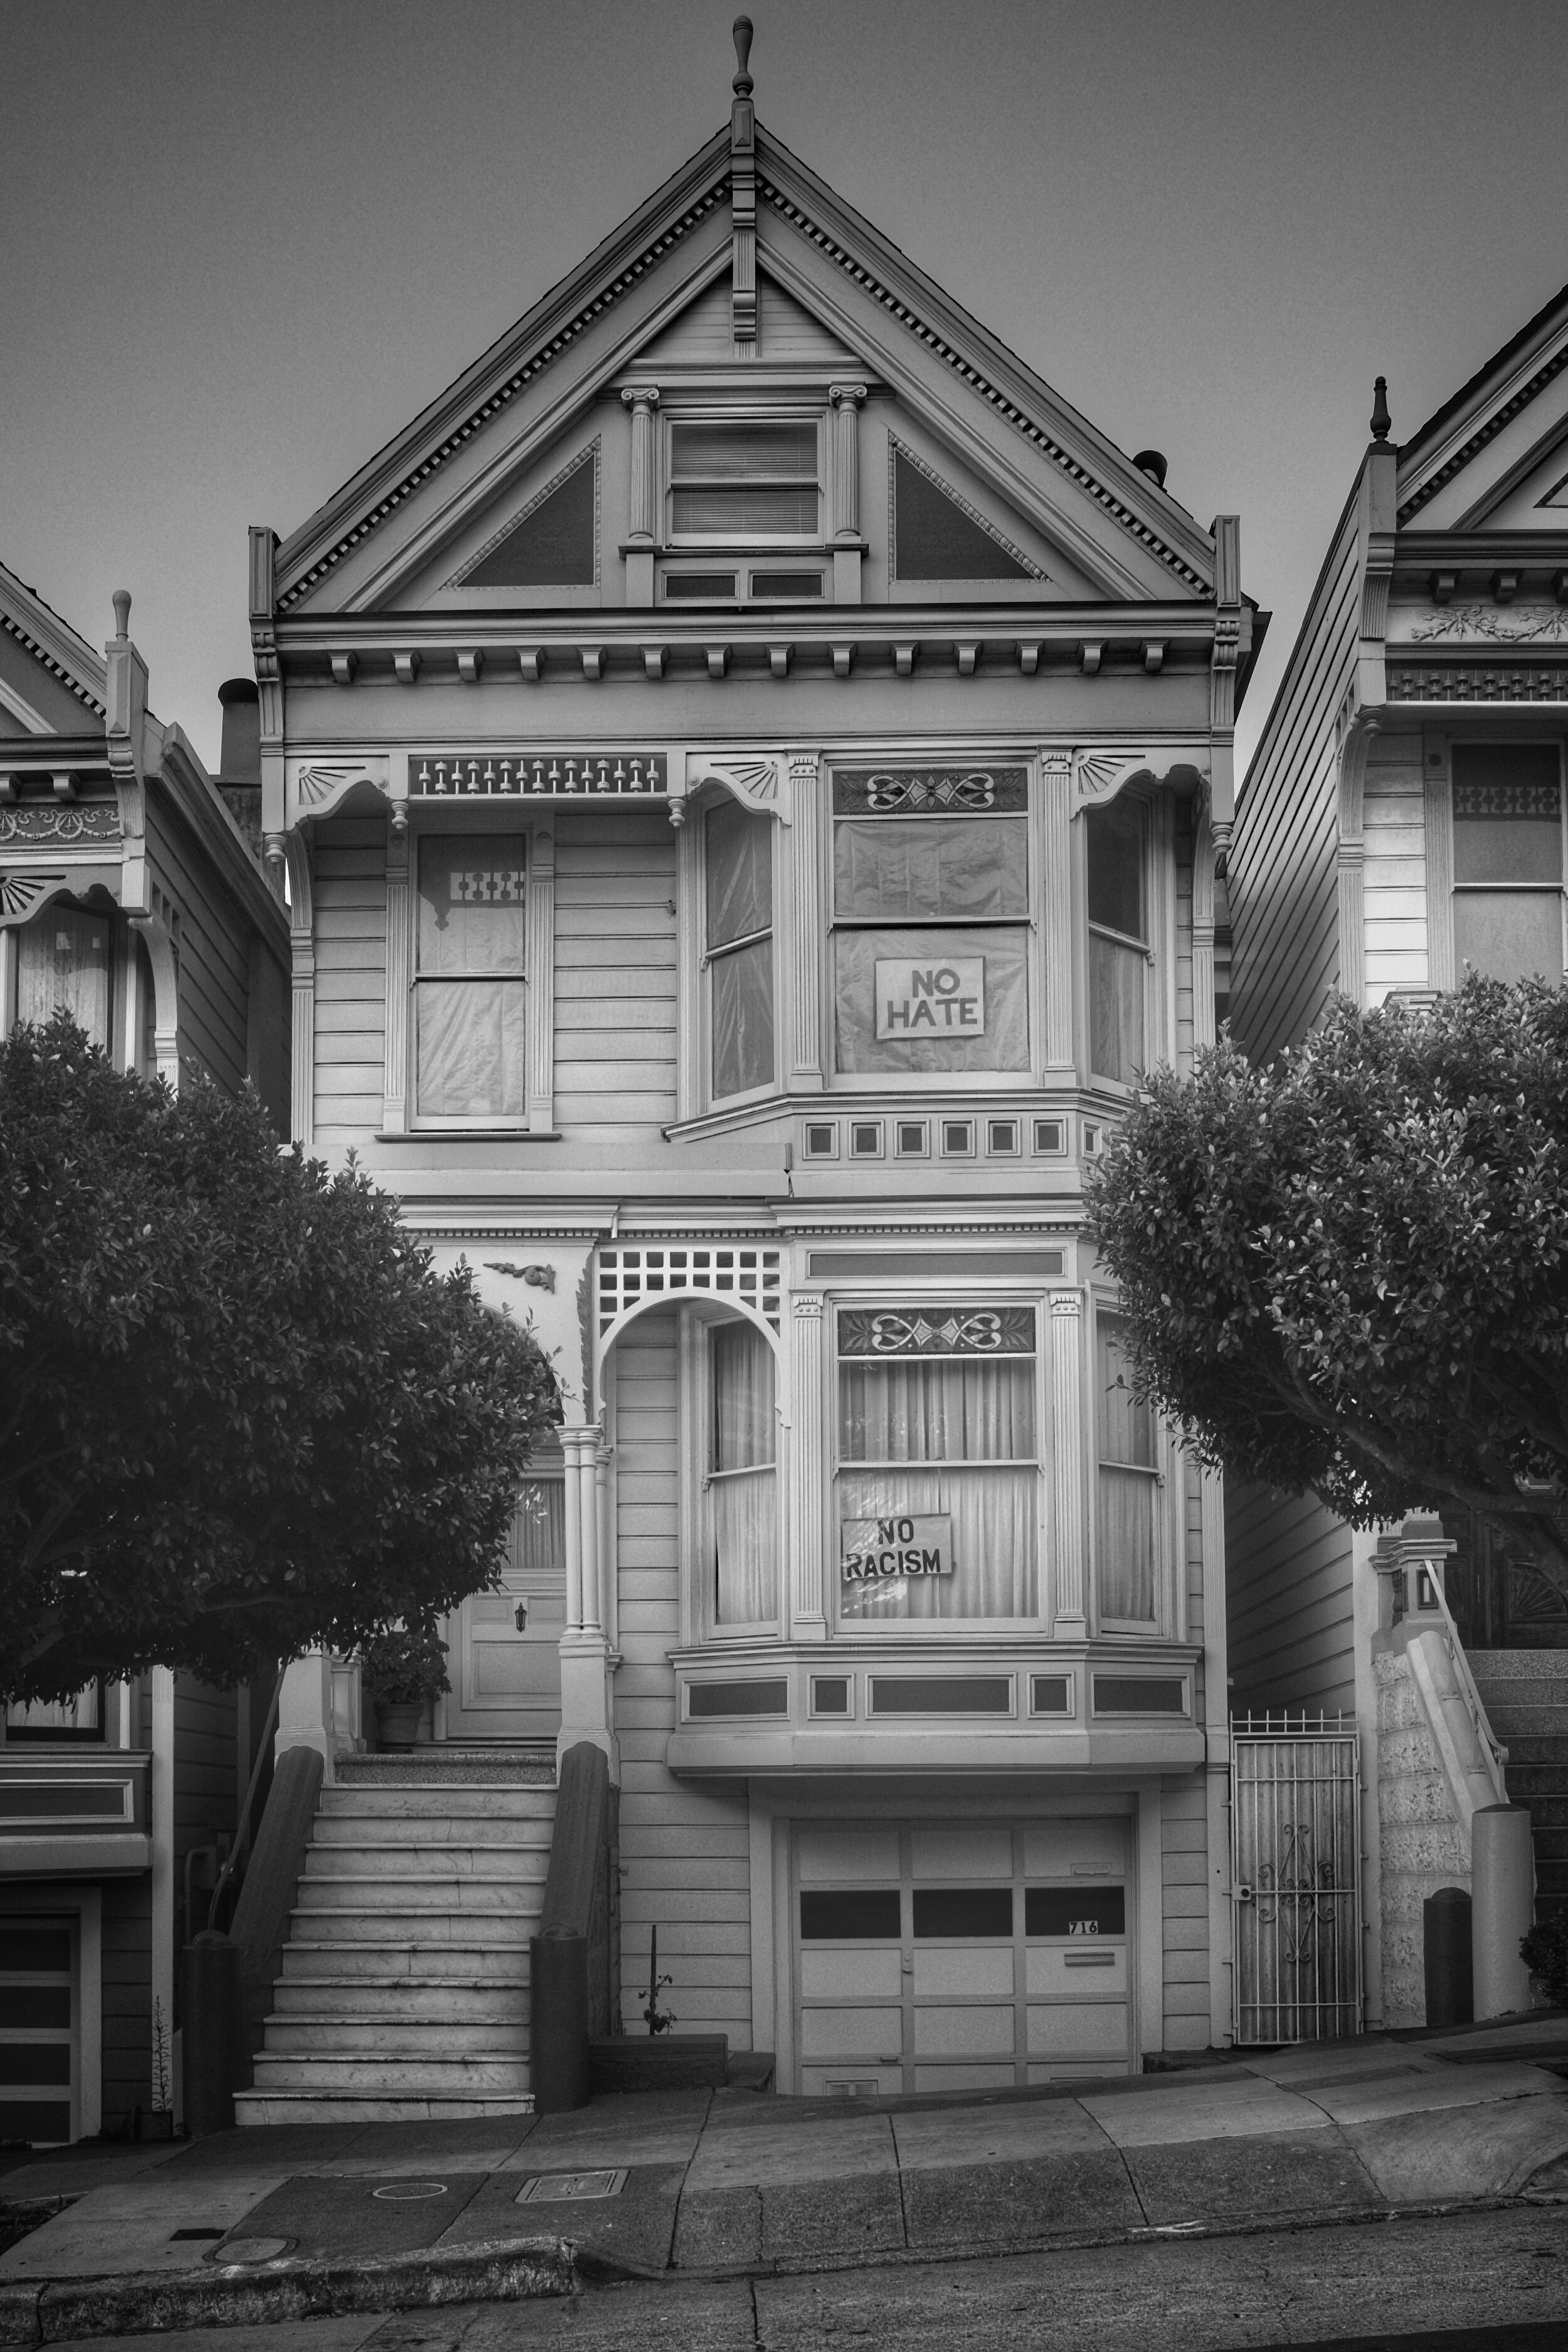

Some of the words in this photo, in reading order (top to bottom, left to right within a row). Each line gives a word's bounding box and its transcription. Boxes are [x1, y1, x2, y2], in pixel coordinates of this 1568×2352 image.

[912, 968, 960, 998] NO
[887, 998, 978, 1029] HATE
[877, 1518, 914, 1545] NO
[846, 1549, 941, 1578] RACISM
[1070, 1921, 1098, 1934] 716
